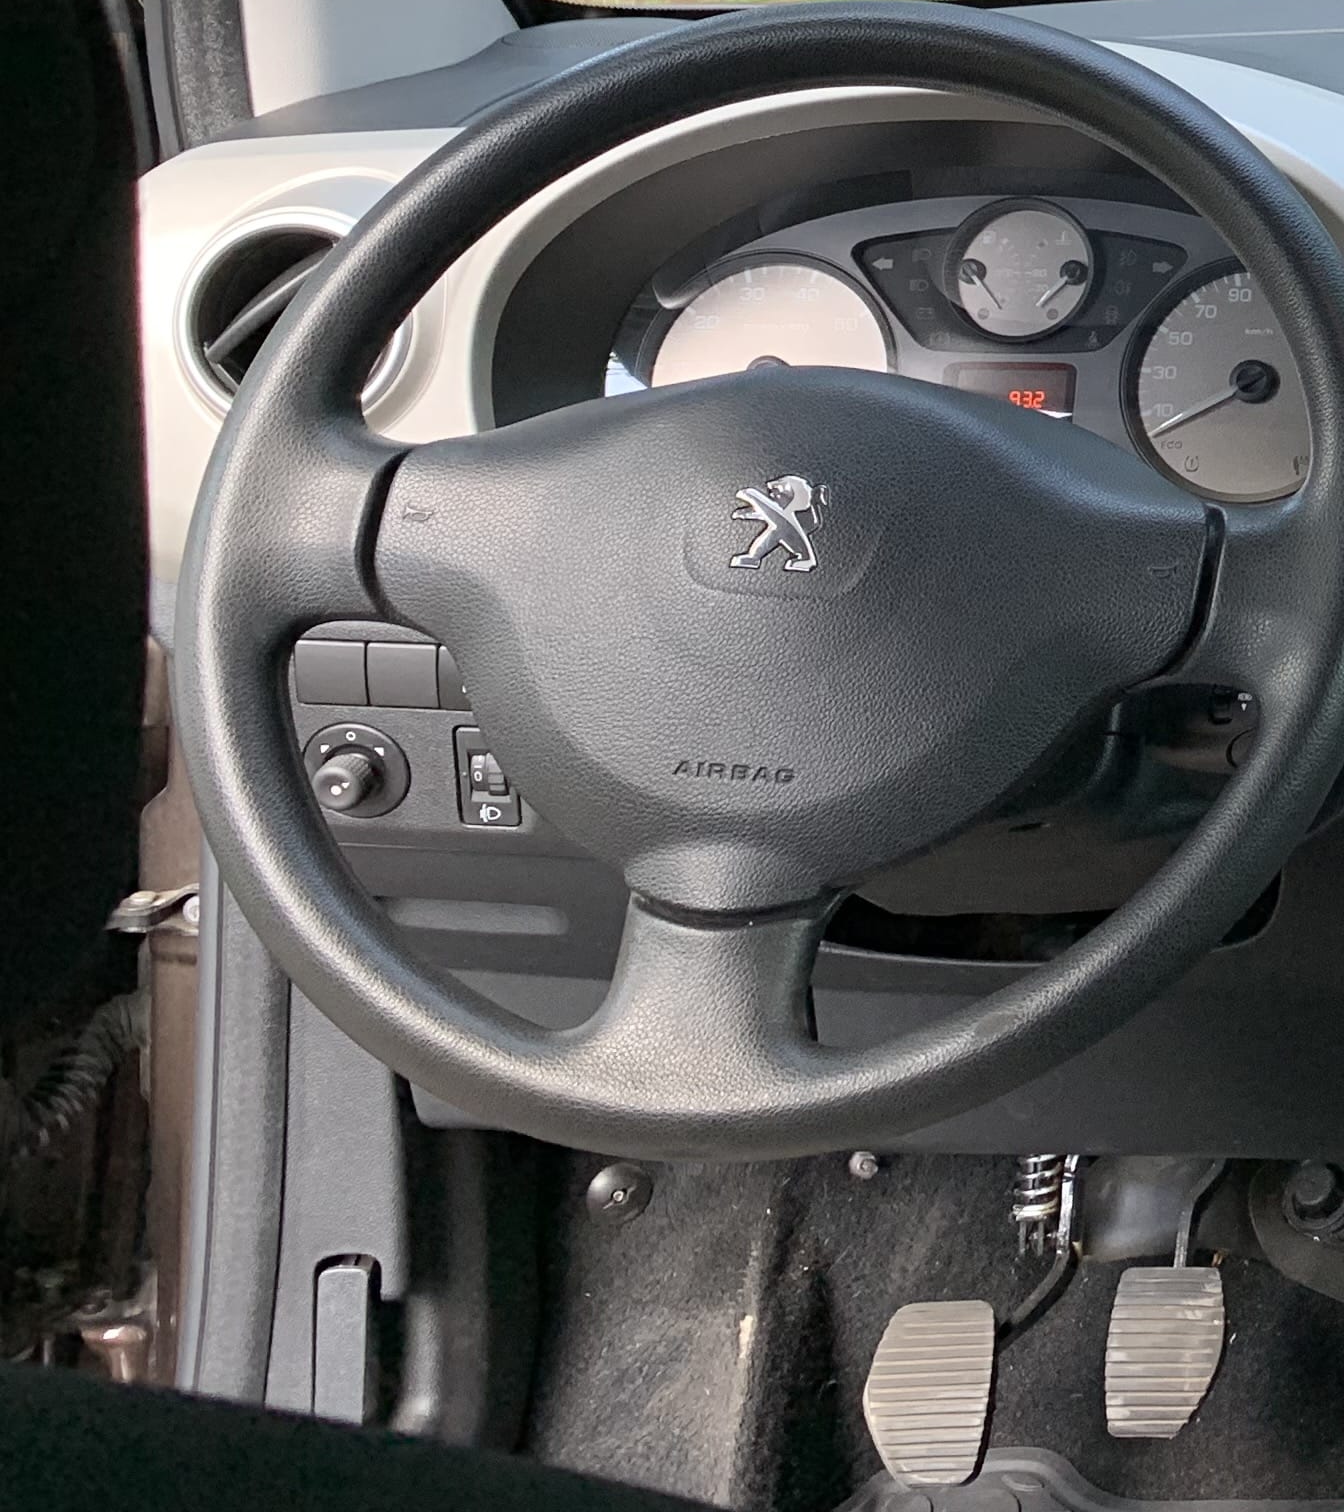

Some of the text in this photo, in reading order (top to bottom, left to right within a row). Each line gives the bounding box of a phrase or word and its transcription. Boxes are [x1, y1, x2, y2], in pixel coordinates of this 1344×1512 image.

[739, 287, 765, 302] 30
[1227, 288, 1252, 302] 90
[1194, 304, 1218, 319] 70
[694, 315, 720, 329] 20
[1167, 331, 1193, 346] 50
[1244, 327, 1274, 336] km/h
[1152, 366, 1177, 380] 30
[1153, 403, 1174, 418] 10
[1160, 440, 1183, 450] ECO
[671, 759, 796, 784] AIRBAG
